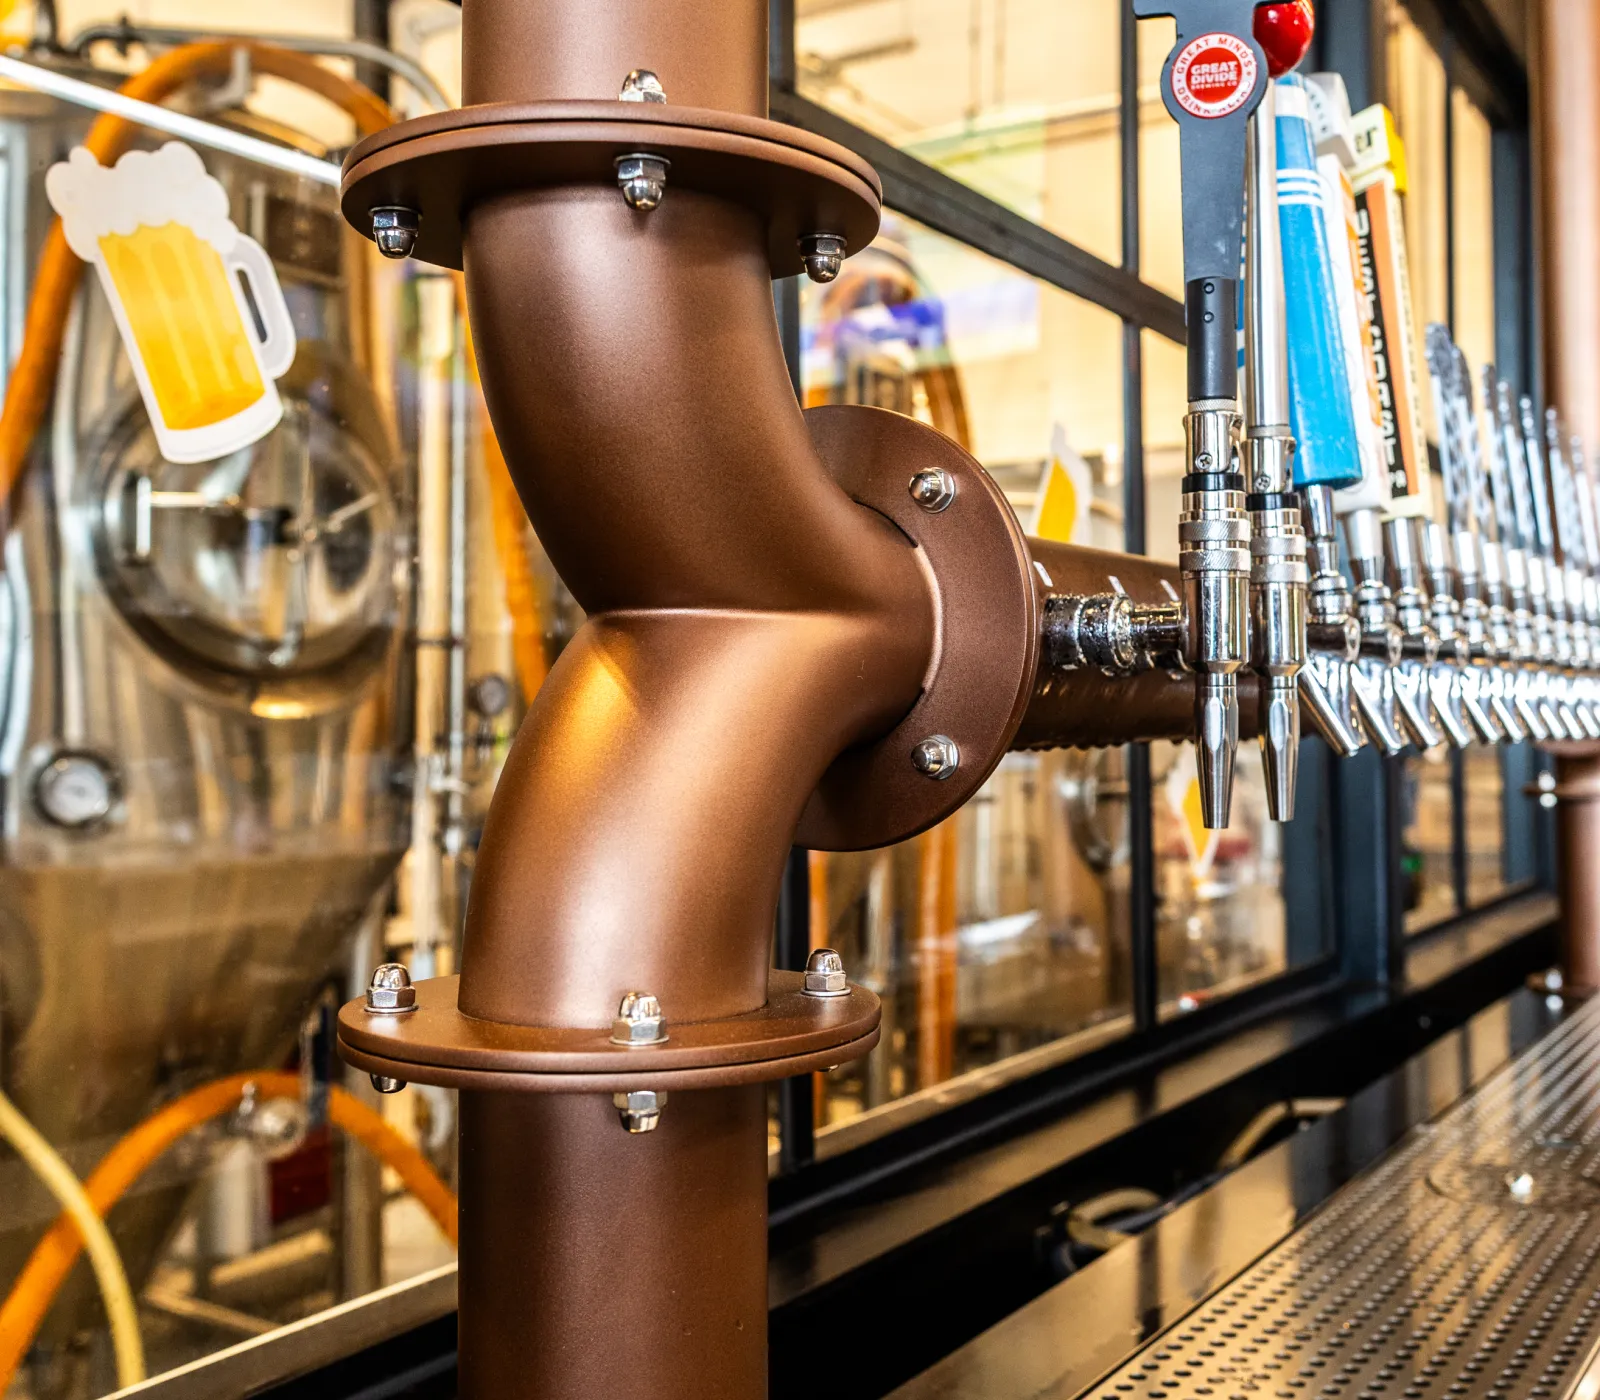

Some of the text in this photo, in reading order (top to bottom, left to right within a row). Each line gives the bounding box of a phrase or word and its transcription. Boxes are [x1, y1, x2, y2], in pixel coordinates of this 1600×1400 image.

[1176, 37, 1253, 75] GREAT MINDS
[1190, 60, 1238, 75] GREAT
[1190, 70, 1238, 85] DIVIDE
